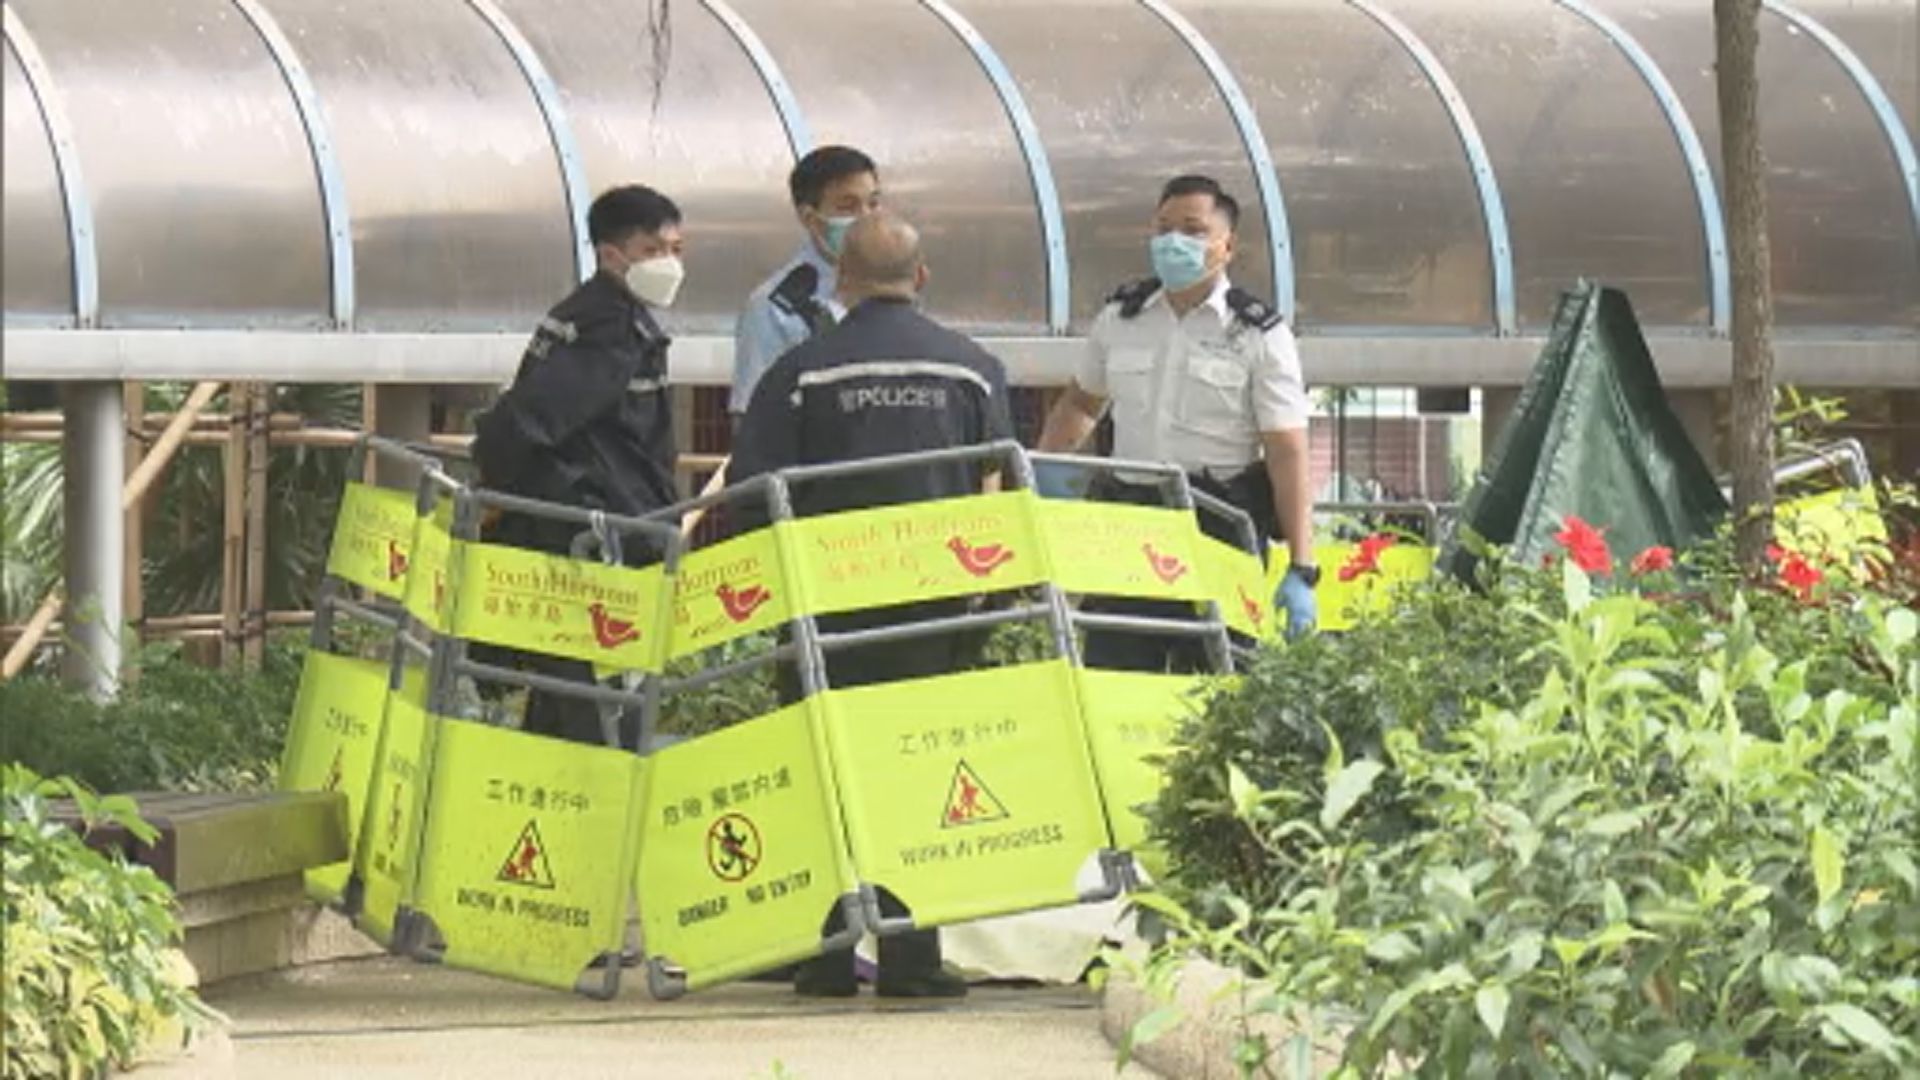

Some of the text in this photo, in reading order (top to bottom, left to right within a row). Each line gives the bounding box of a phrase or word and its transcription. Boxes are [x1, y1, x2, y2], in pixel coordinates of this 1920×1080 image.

[858, 385, 930, 408] POLICE
[899, 822, 1064, 867] WORK IN PROGRESS
